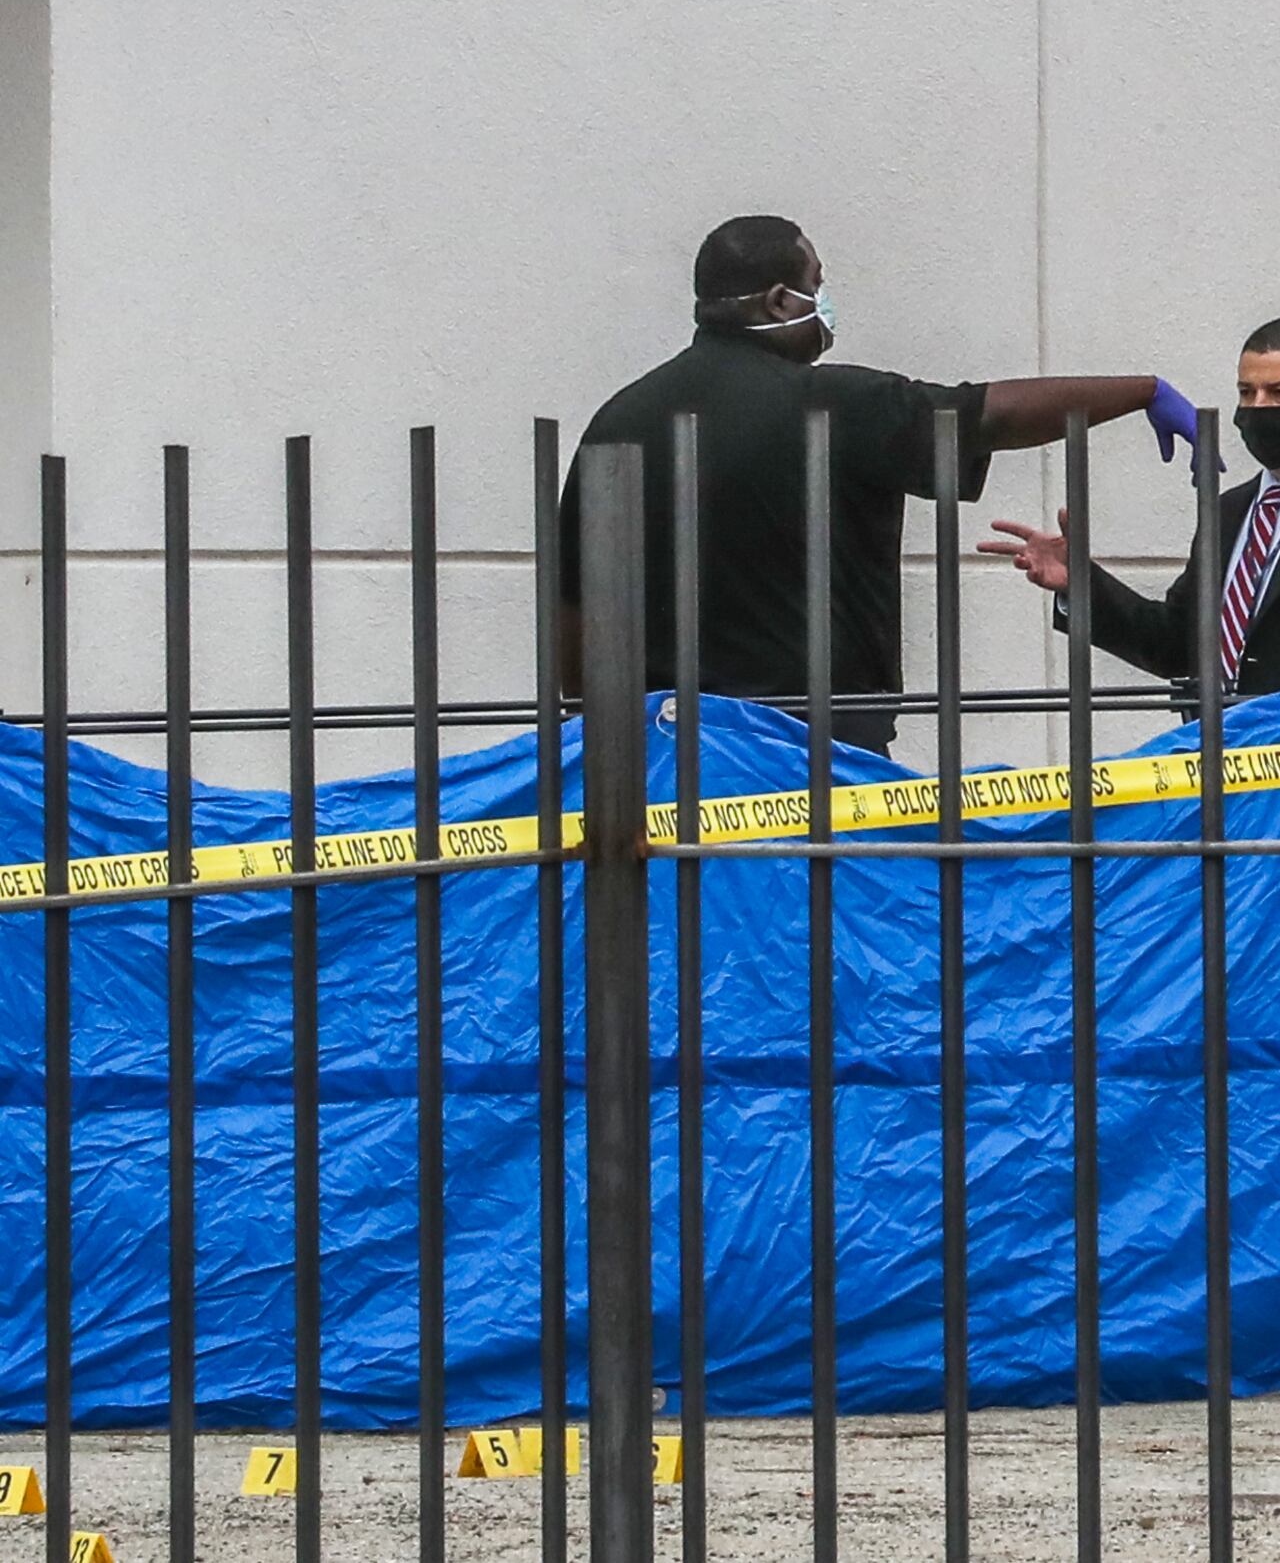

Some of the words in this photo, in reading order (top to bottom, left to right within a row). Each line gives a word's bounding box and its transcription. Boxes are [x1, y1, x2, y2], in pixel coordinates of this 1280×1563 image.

[1185, 754, 1248, 789] POCE
[882, 784, 941, 817] POLICE
[961, 780, 989, 810] NE
[990, 776, 1016, 806] DO
[1019, 772, 1053, 803] NOT
[1055, 766, 1115, 800] CSS
[713, 802, 750, 833] NOT
[752, 795, 811, 828] CROSS
[272, 841, 338, 873] POCE
[336, 837, 379, 867] LINE
[380, 834, 407, 862] DO
[447, 824, 508, 856] CROSS
[0, 870, 28, 898] ICE
[71, 863, 99, 891] DO
[100, 860, 137, 888] NOT
[140, 855, 201, 885] CRS
[263, 1452, 285, 1485] 7
[487, 1436, 510, 1468] 5
